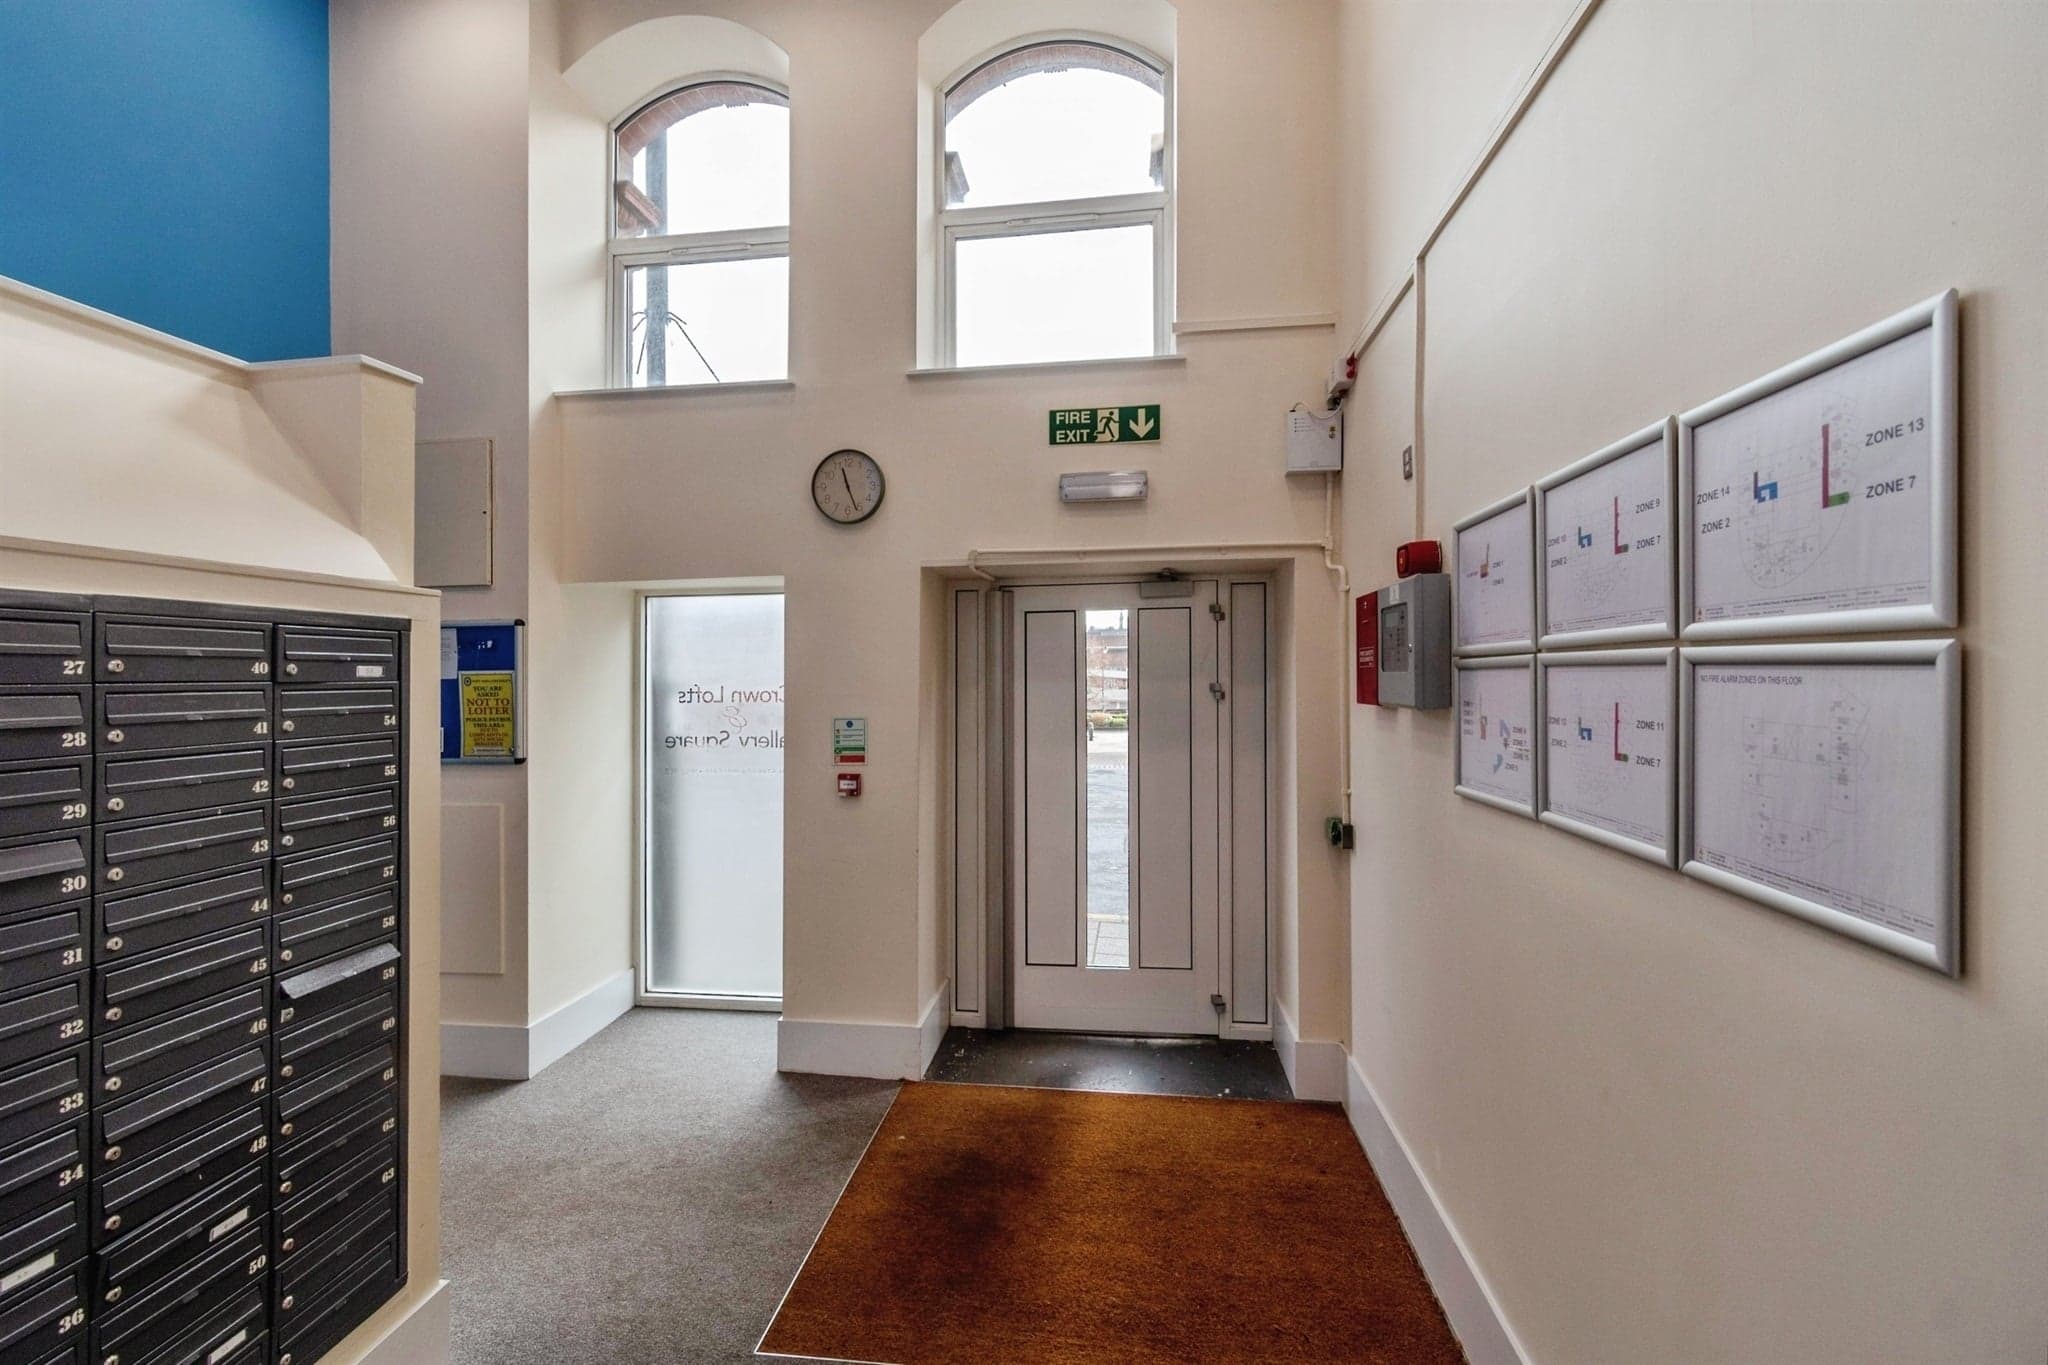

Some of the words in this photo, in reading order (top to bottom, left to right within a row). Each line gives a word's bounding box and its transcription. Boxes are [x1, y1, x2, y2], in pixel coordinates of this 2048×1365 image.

[1056, 411, 1091, 425] FIRE
[1056, 429, 1090, 443] EXIT
[1865, 424, 1903, 447] ZONE
[1907, 417, 1925, 433] 13
[824, 471, 835, 480] 10
[1866, 478, 1903, 499] ZONE
[1908, 476, 1917, 489] 7
[824, 494, 831, 504] 8
[1697, 488, 1719, 505] ZONE
[1721, 485, 1731, 498] 14
[1635, 501, 1654, 514] ZONE
[1701, 519, 1724, 535] ZONE
[1725, 518, 1731, 528] 2
[1636, 537, 1655, 550] ZONE
[1656, 535, 1661, 545] 7
[64, 661, 85, 674] 27
[252, 663, 268, 673] 40
[466, 698, 489, 706] NOT
[495, 698, 510, 706] TO
[468, 707, 509, 715] LOITER
[254, 722, 267, 733] 41
[384, 716, 396, 726] 54
[1636, 720, 1654, 730] ZONE
[1657, 722, 1664, 731] 11
[63, 732, 86, 747] 28
[1636, 755, 1655, 767] ZONE
[1656, 758, 1661, 768] 7
[385, 765, 397, 776] 55
[253, 781, 268, 792] 42
[63, 804, 86, 819] 29
[384, 816, 396, 827] 56
[252, 840, 268, 853] 43
[384, 866, 395, 878] 57
[62, 876, 86, 892] 30
[251, 899, 267, 912] 44
[383, 916, 395, 929] 58
[63, 948, 81, 965] 31
[250, 958, 266, 972] 45
[383, 967, 395, 980] 59
[61, 1020, 83, 1038] 32
[250, 1019, 267, 1033] 46
[383, 1017, 396, 1031] 60
[384, 1068, 394, 1081] 61
[251, 1077, 266, 1092] 47
[60, 1093, 83, 1112] 33
[383, 1118, 395, 1132] 62
[250, 1136, 266, 1152] 48
[60, 1164, 83, 1186] 34
[382, 1168, 395, 1183] 63
[249, 1255, 266, 1274] 50
[59, 1309, 84, 1333] 36
